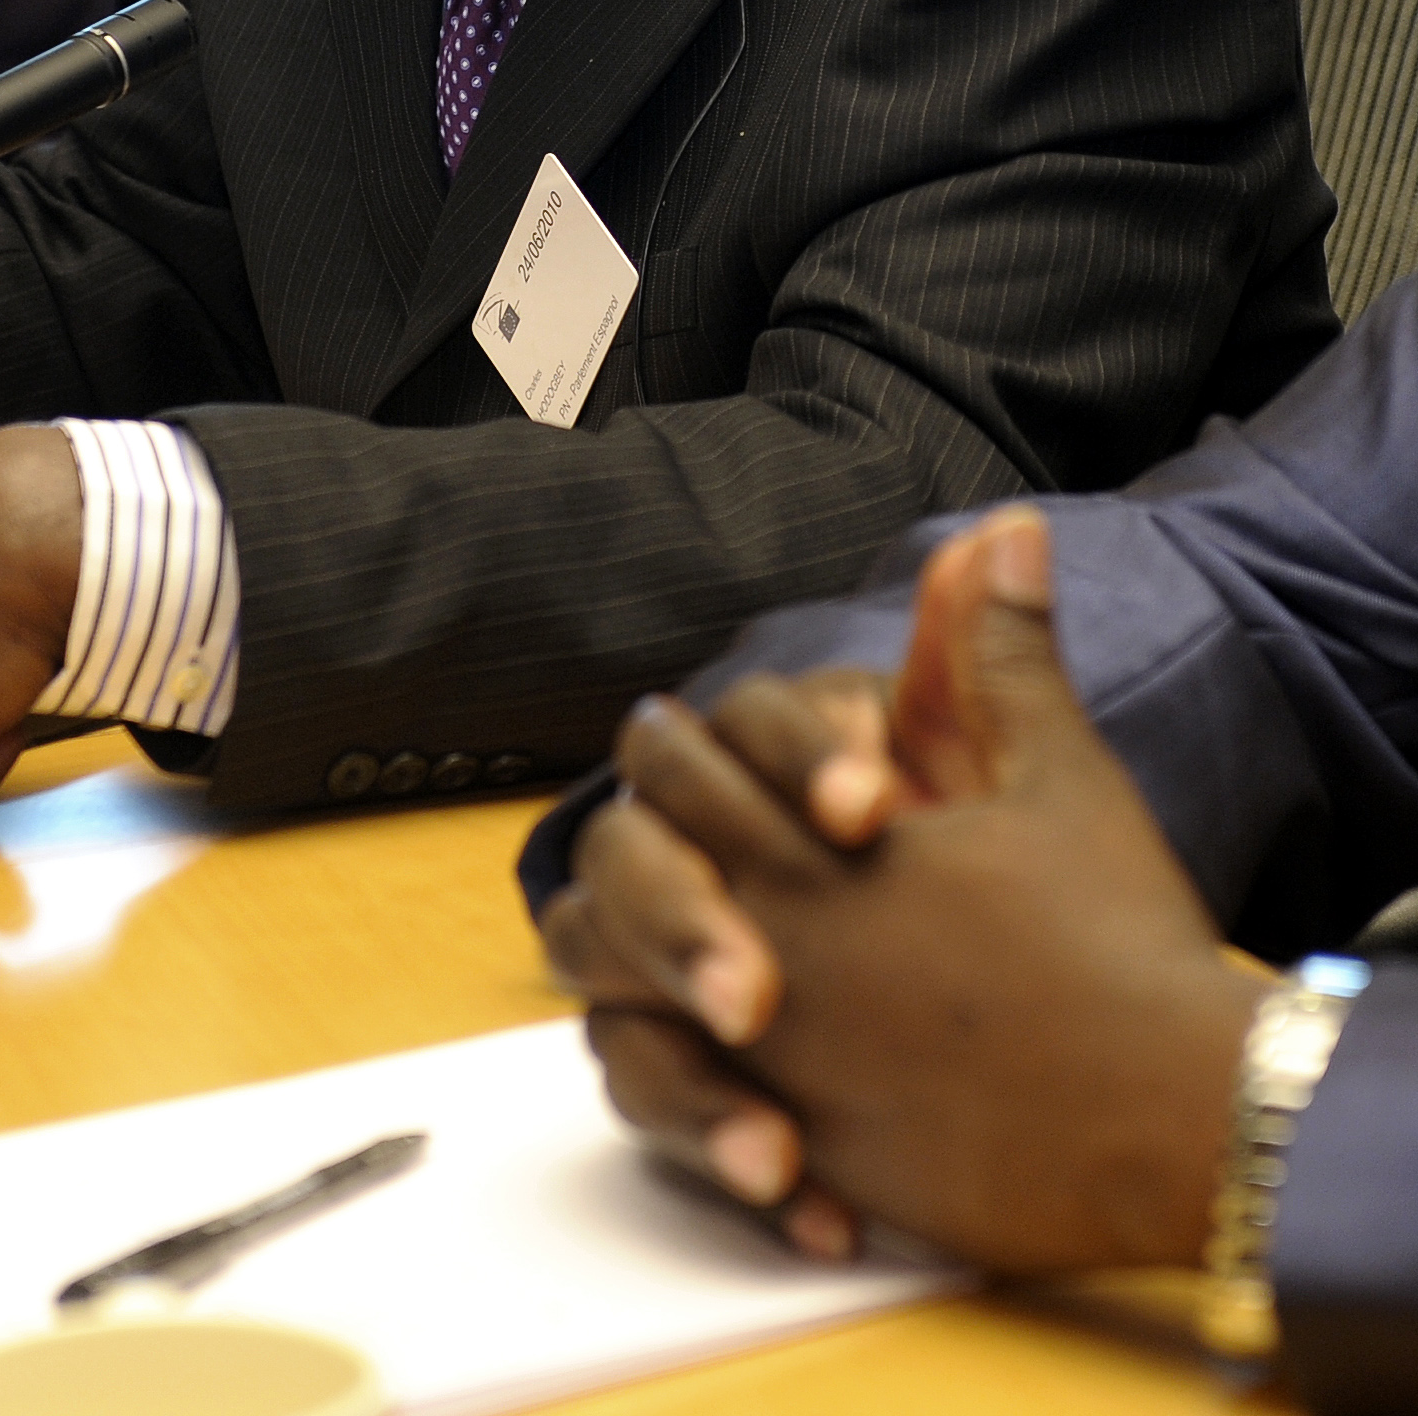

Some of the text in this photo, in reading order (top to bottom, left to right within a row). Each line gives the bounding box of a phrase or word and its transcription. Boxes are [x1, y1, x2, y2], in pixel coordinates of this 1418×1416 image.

[517, 190, 562, 283] 24/06/2010
[524, 368, 543, 401] Charles
[558, 399, 572, 421] PN
[569, 343, 599, 396] Parlement
[592, 294, 619, 346] Espagnol
